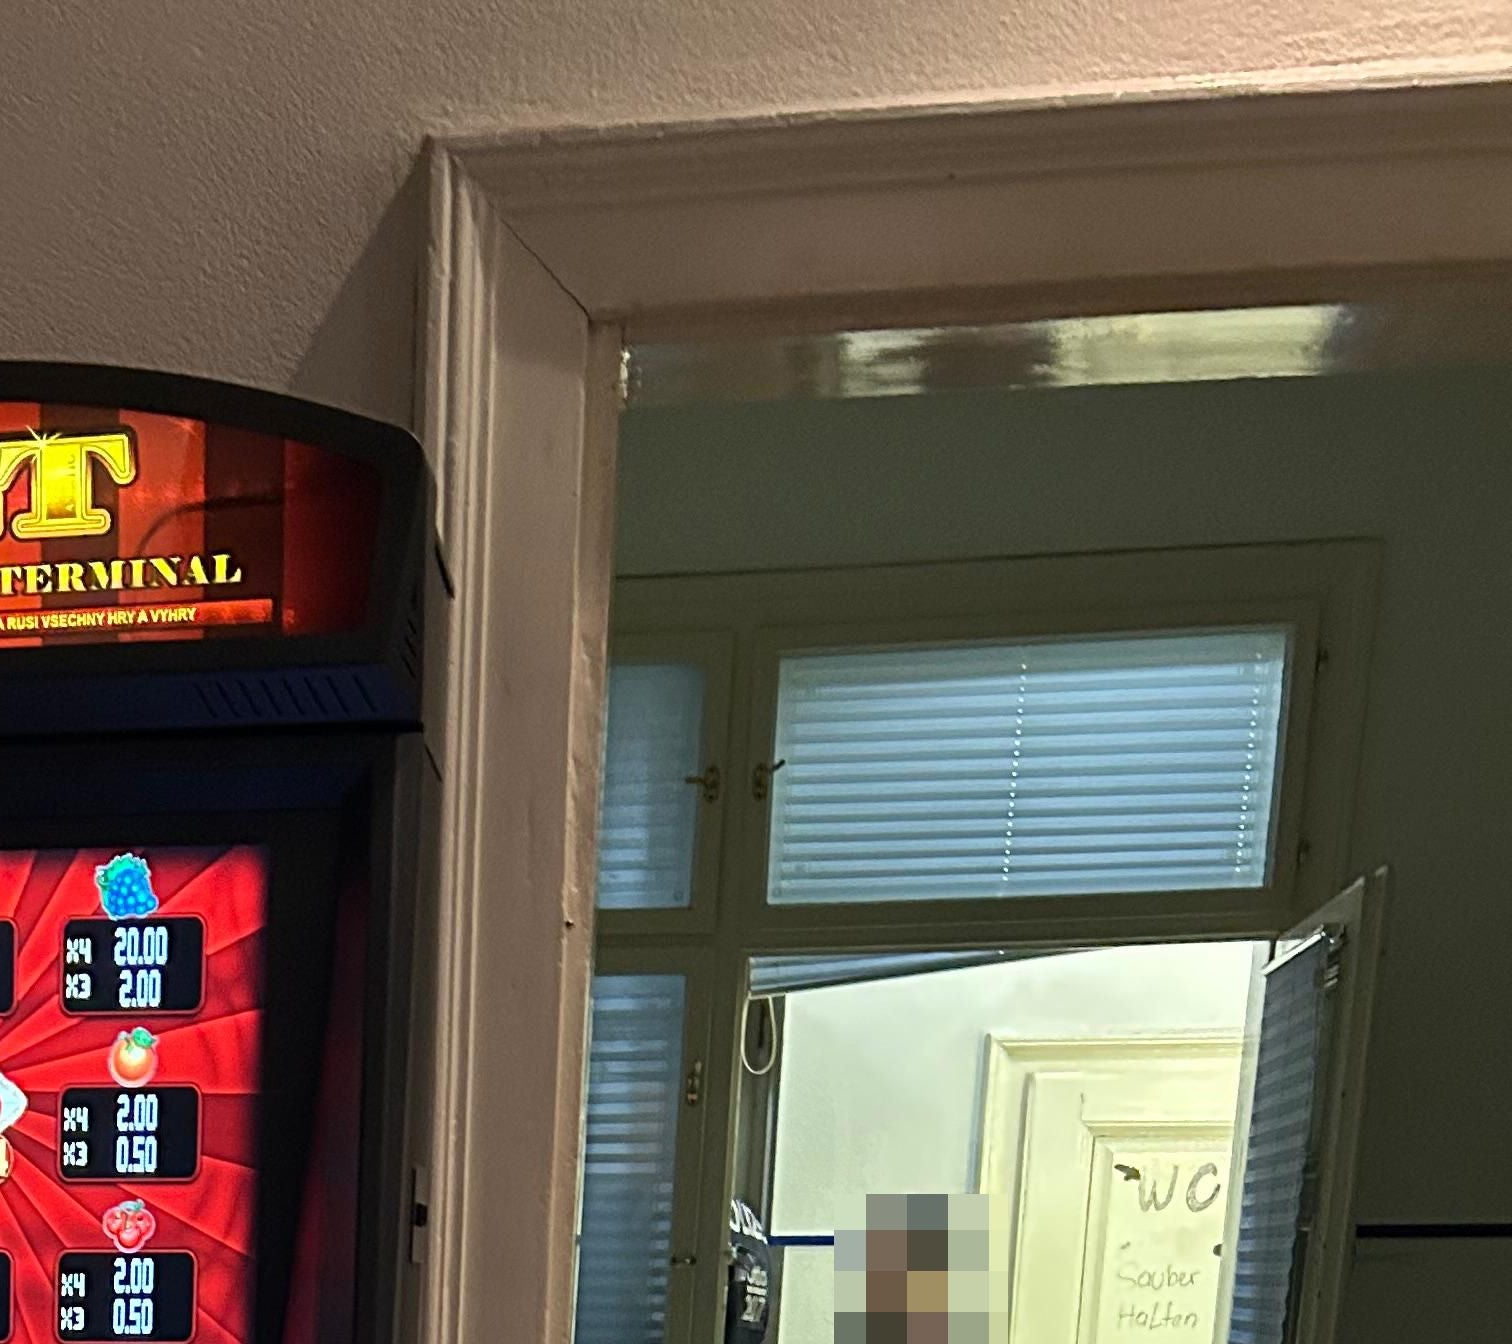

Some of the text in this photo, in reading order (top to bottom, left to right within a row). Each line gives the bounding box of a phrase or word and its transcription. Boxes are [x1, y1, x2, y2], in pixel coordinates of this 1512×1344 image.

[6, 614, 39, 630] RUSI
[41, 611, 106, 628] VSECHNY
[108, 610, 136, 626] HRY
[137, 609, 148, 624] A
[150, 607, 197, 623] VYHRY
[114, 926, 168, 966] 20.00
[119, 969, 161, 1008] 2.00
[117, 1094, 158, 1132] 2.00
[116, 1135, 157, 1173] 0.50
[1138, 1162, 1221, 1213] WC
[114, 1257, 154, 1294] 2.00
[1116, 1262, 1200, 1290] Sauber
[113, 1298, 153, 1335] 0.50
